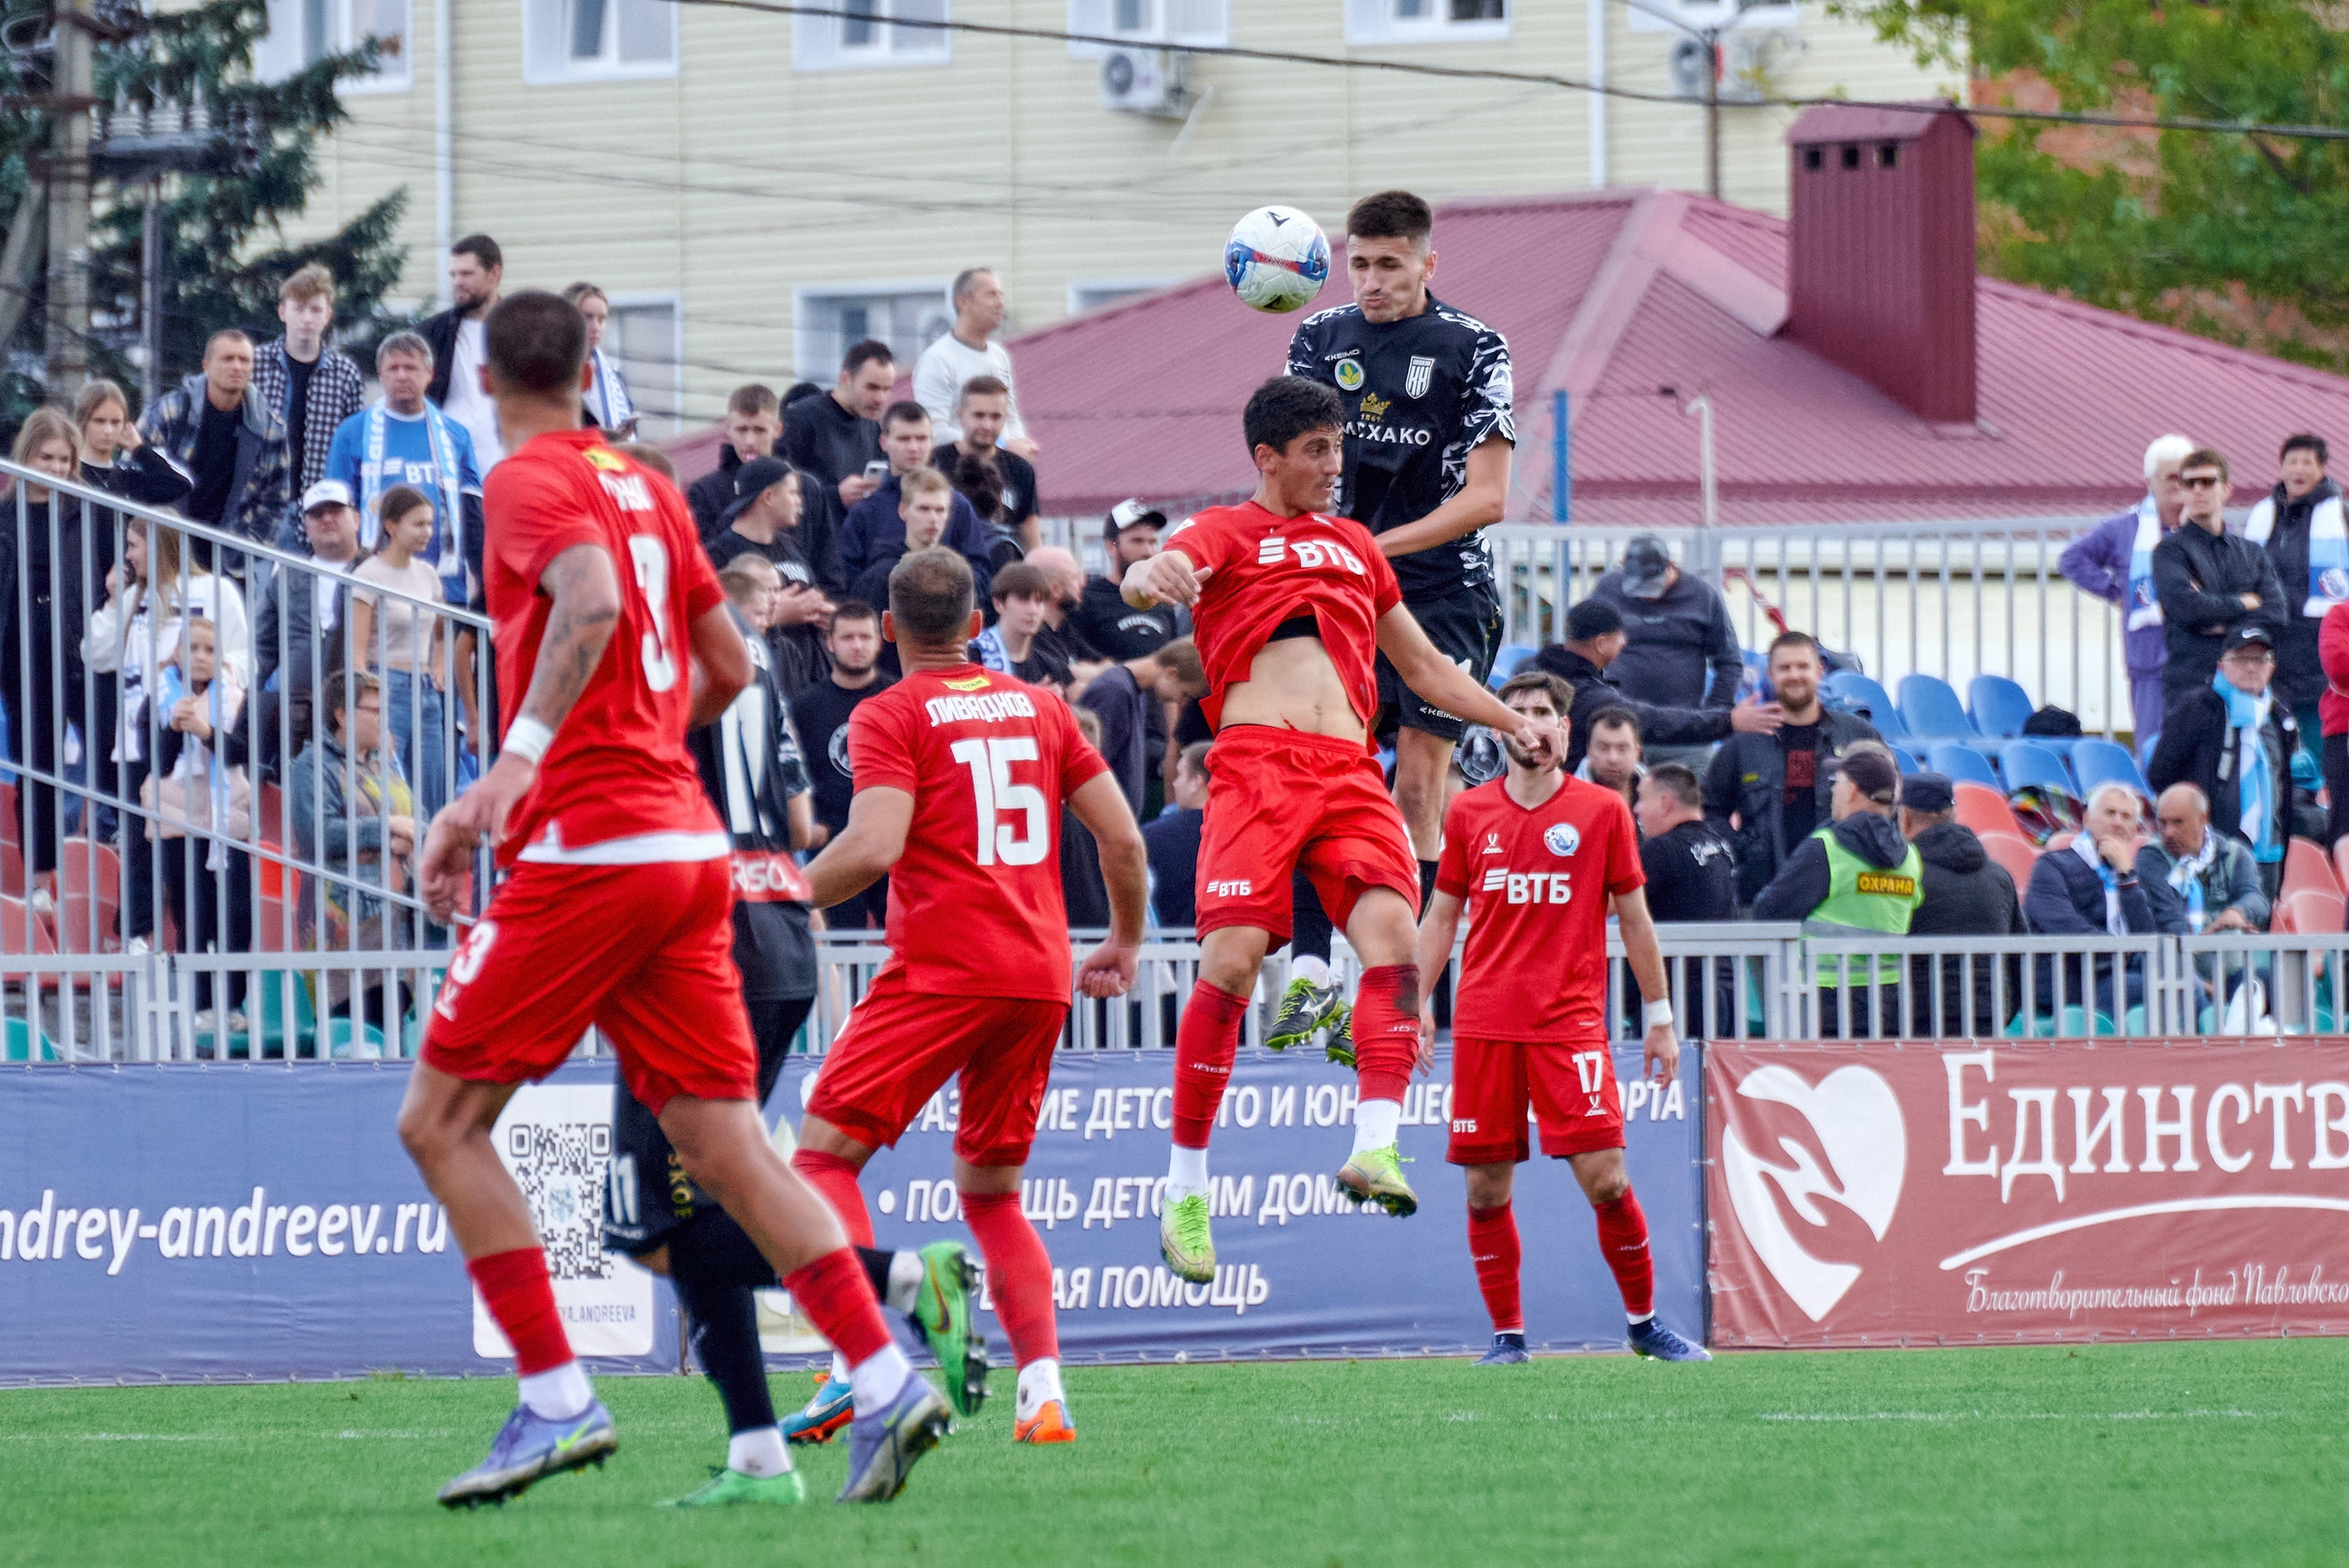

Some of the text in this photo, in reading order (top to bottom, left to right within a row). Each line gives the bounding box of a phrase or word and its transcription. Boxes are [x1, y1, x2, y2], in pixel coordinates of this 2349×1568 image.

[1289, 539, 1365, 576] ВТБ
[925, 692, 1034, 727] ЛИВАДНОВ
[950, 738, 1048, 866] 15
[1219, 880, 1252, 897] ВТБ
[1508, 873, 1572, 905] ВТБ
[1858, 874, 1913, 895] ОХРАНА
[1572, 1051, 1603, 1094] 17
[1269, 1085, 1296, 1128] И
[1453, 1119, 1476, 1133] ВТБ
[1965, 1267, 2180, 1320] Благотворительный
[2186, 1268, 2238, 1318] фонд
